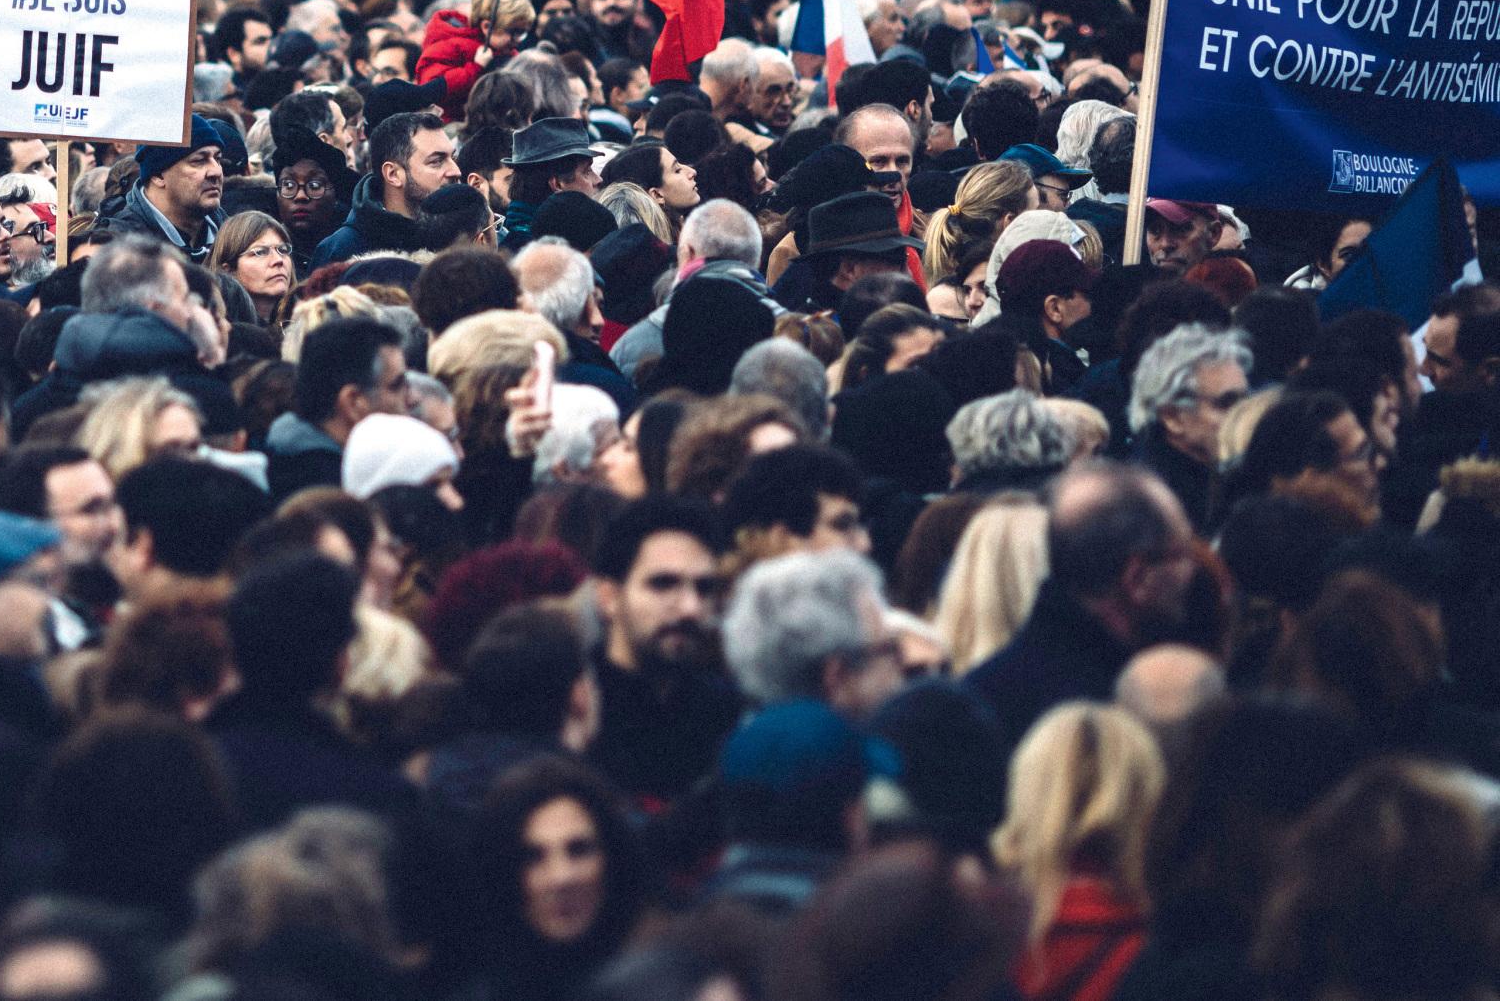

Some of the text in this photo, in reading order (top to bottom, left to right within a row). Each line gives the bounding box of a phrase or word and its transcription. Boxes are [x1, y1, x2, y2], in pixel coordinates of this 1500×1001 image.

[11, 30, 119, 97] JUIF
[1199, 27, 1238, 72] ET
[1249, 35, 1376, 92] CONTRE
[1353, 154, 1419, 175] BOULOGNE-
